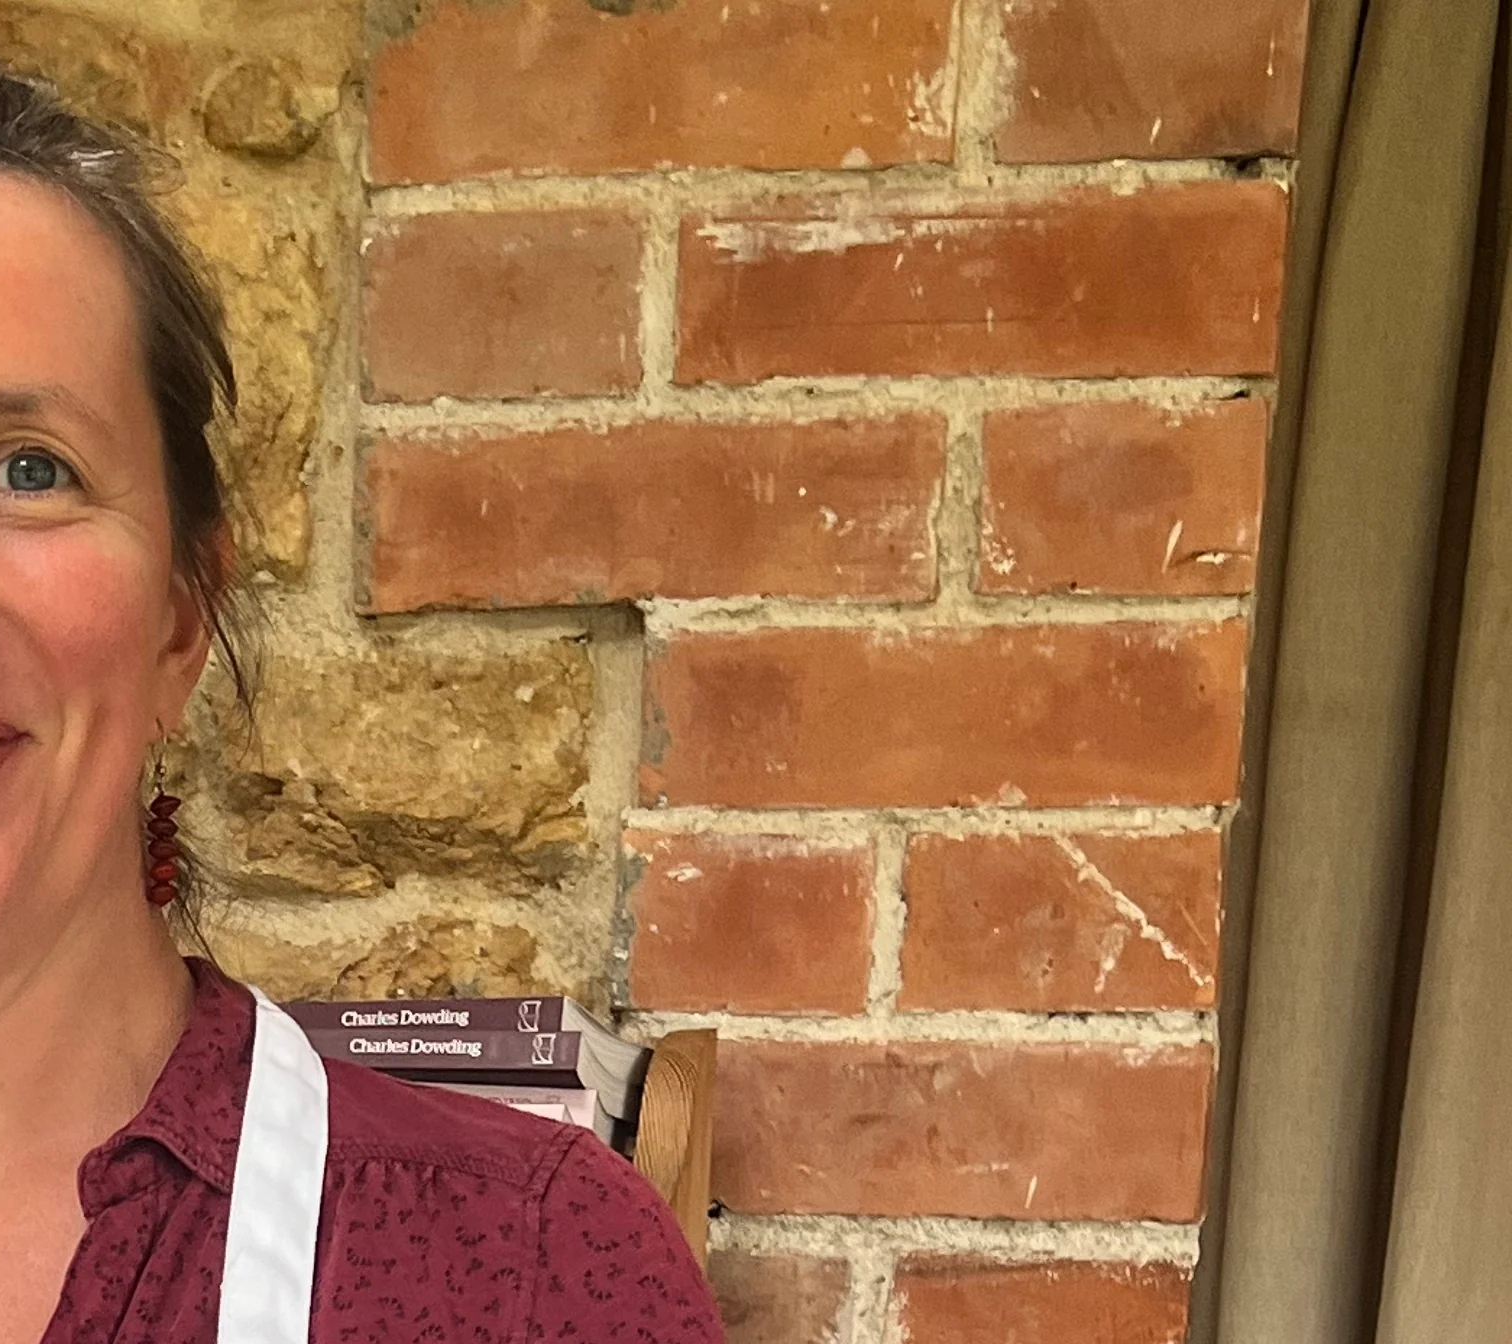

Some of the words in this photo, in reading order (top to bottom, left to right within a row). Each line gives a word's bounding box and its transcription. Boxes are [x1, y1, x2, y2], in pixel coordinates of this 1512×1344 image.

[341, 1009, 398, 1026] Charles
[400, 1009, 469, 1027] Dowding
[349, 1038, 410, 1055] Charles
[410, 1038, 482, 1058] Dowding
